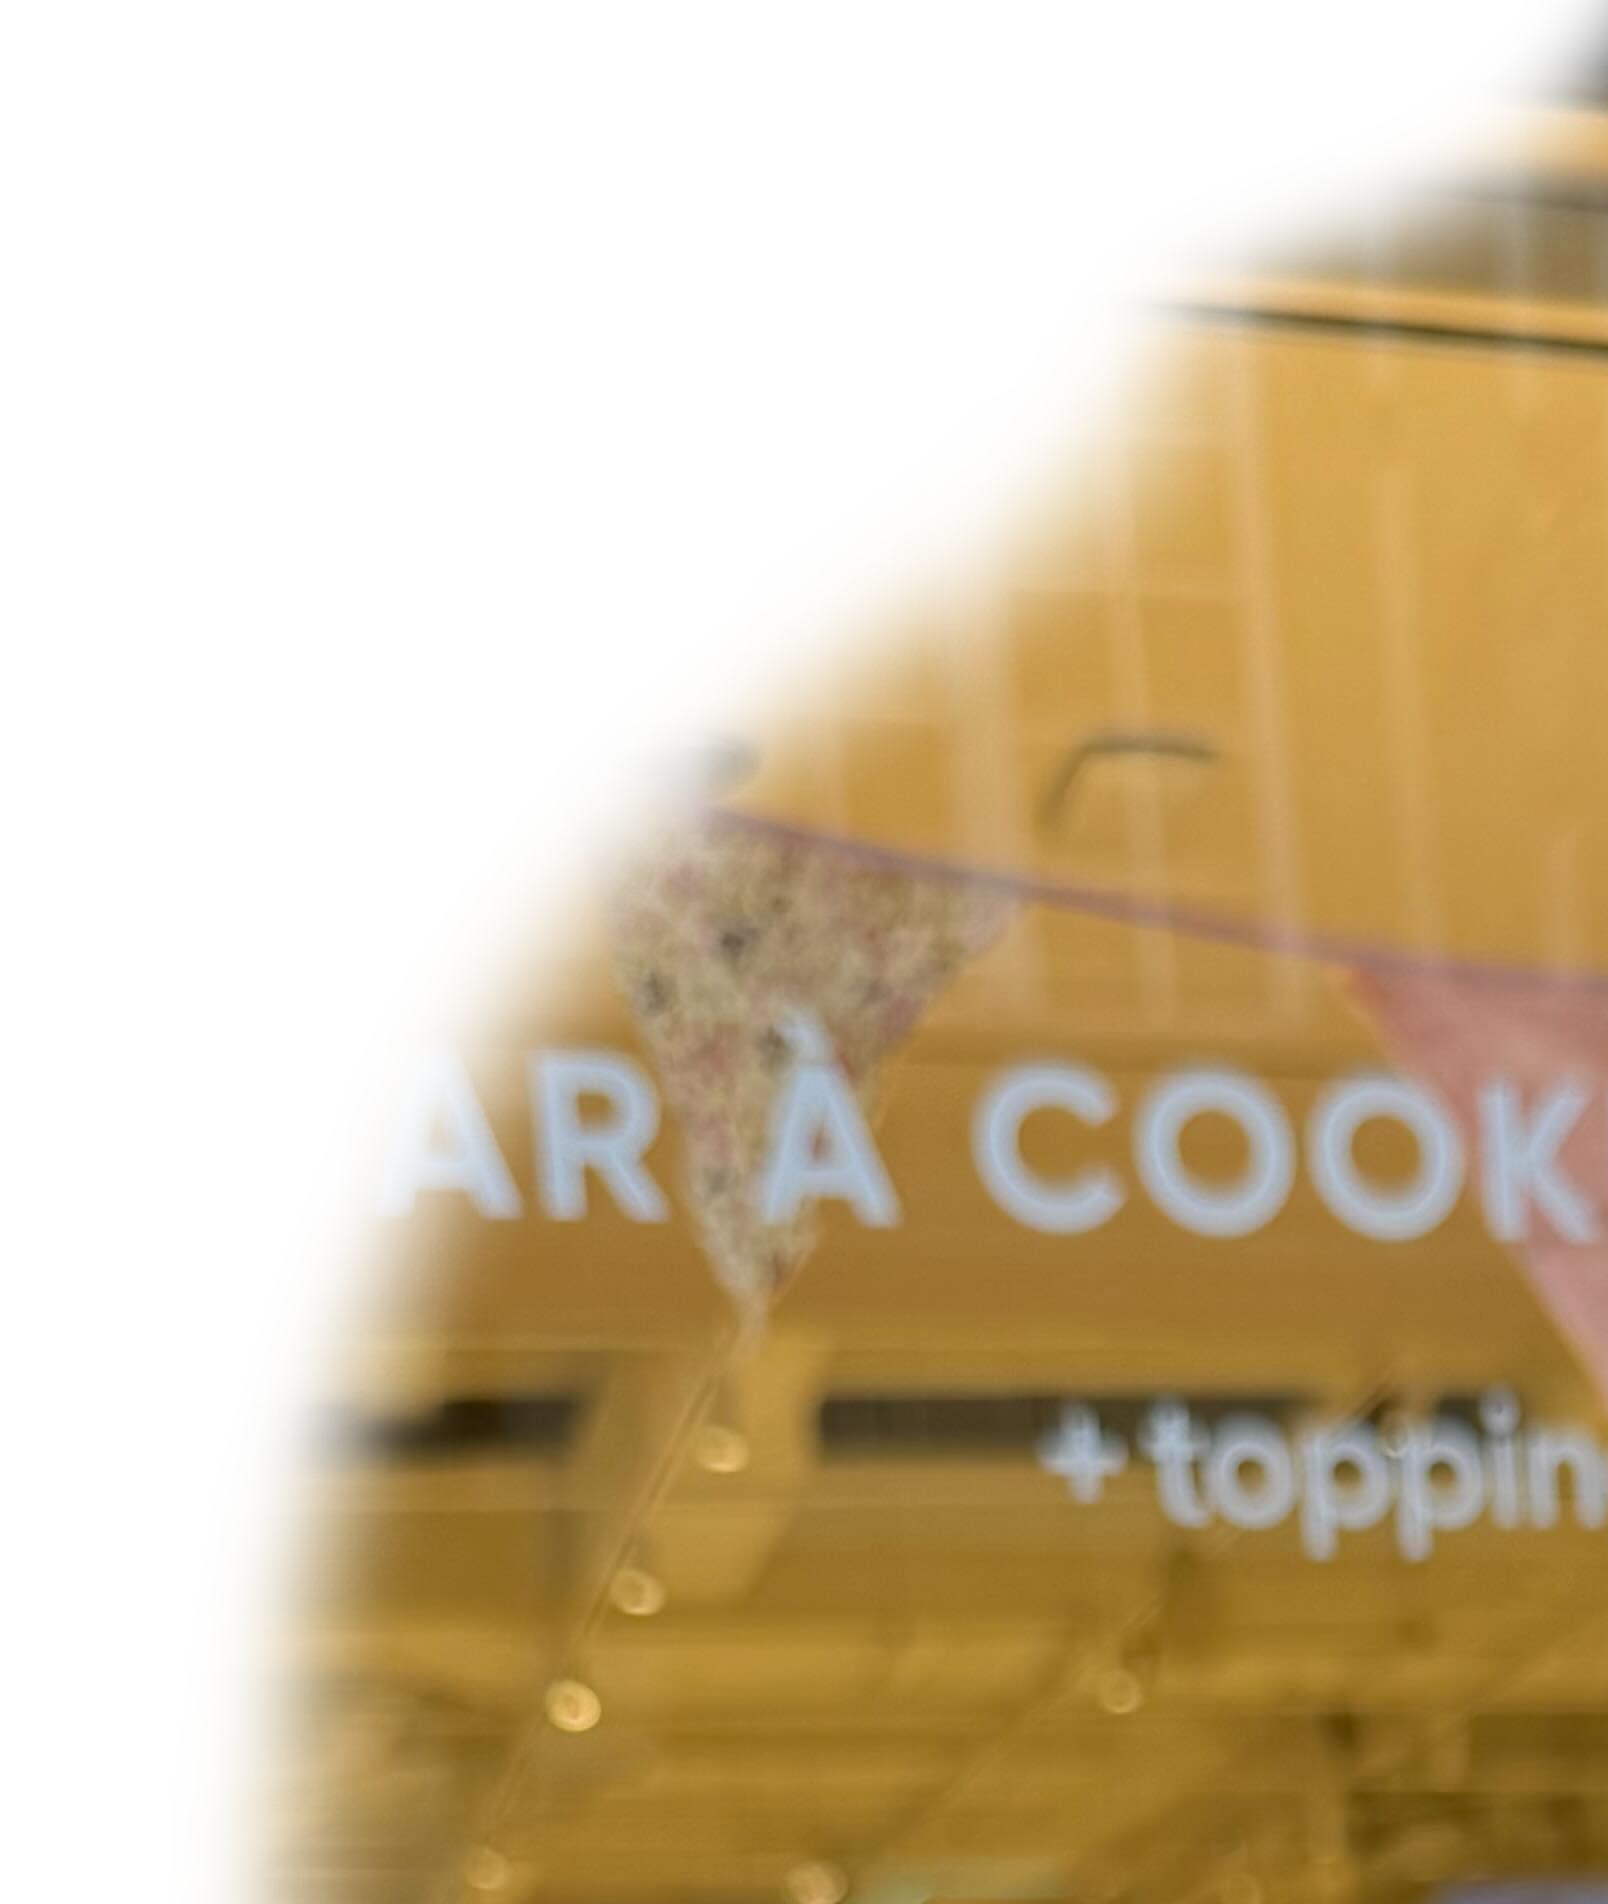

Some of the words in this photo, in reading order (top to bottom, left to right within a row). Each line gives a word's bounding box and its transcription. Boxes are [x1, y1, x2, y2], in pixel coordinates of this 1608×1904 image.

[302, 1046, 668, 1220] AR
[750, 1004, 899, 1226] À
[1040, 1407, 1125, 1502] +
